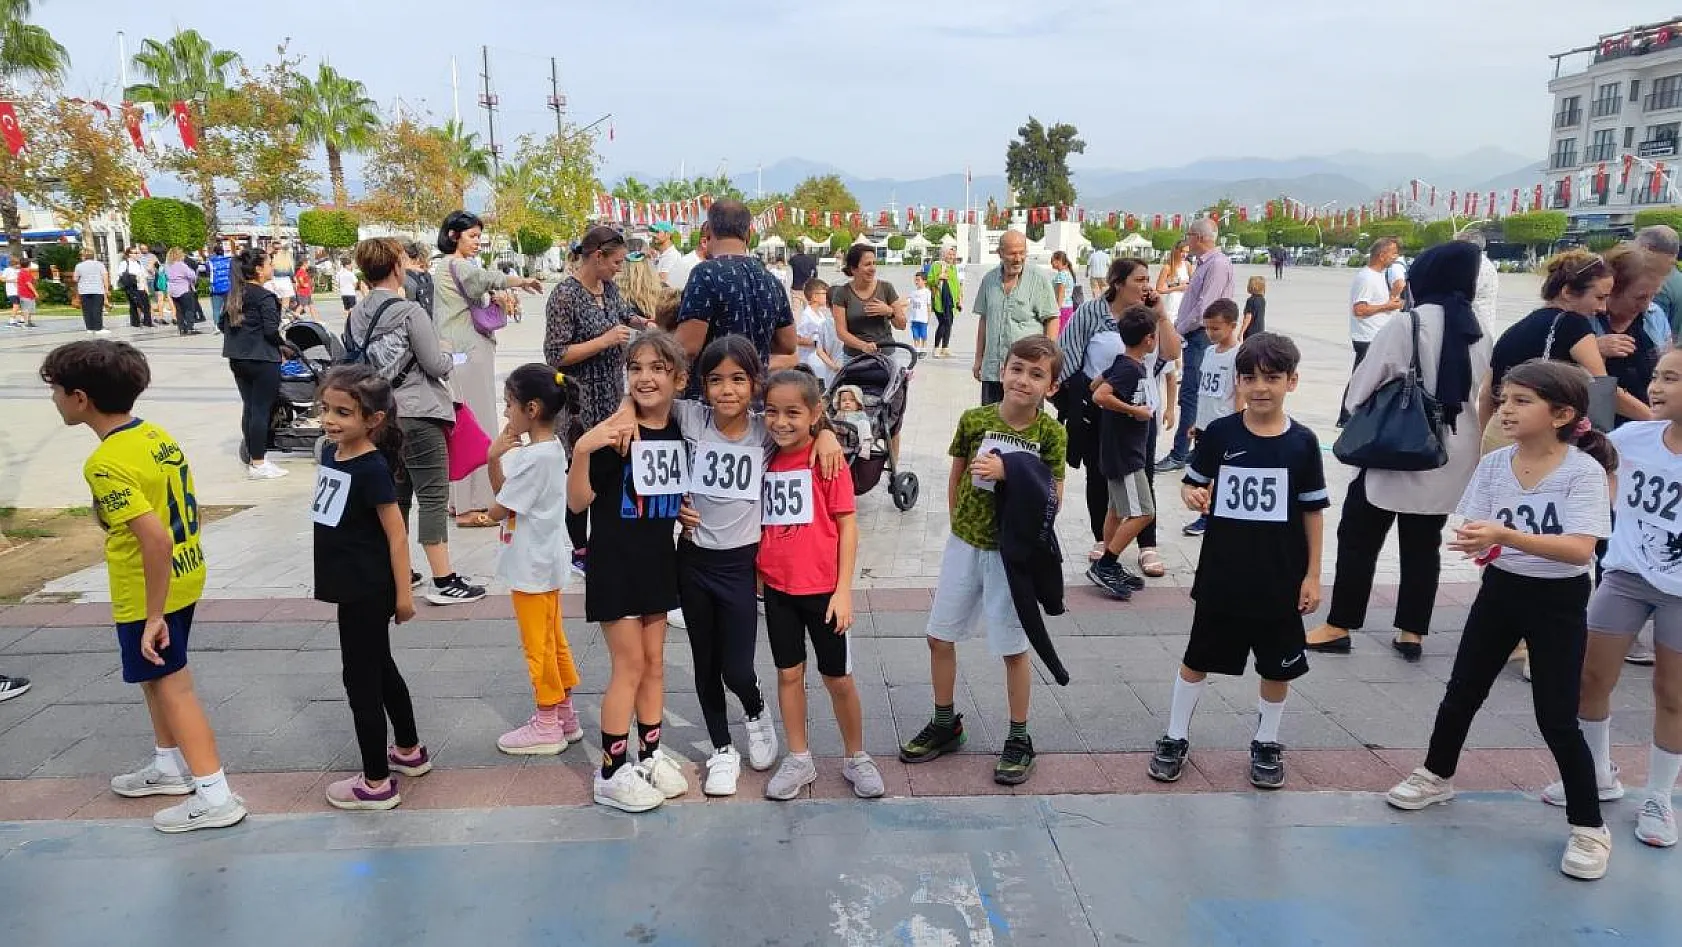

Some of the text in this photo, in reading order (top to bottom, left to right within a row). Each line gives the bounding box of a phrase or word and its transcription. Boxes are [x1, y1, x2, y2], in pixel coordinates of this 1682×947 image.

[1201, 372, 1220, 393] 35
[641, 449, 681, 487] 354
[703, 451, 753, 490] 330
[167, 464, 198, 544] 16
[765, 478, 803, 516] 355
[1226, 474, 1277, 512] 365
[1627, 470, 1682, 521] 332
[1496, 502, 1563, 535] 334
